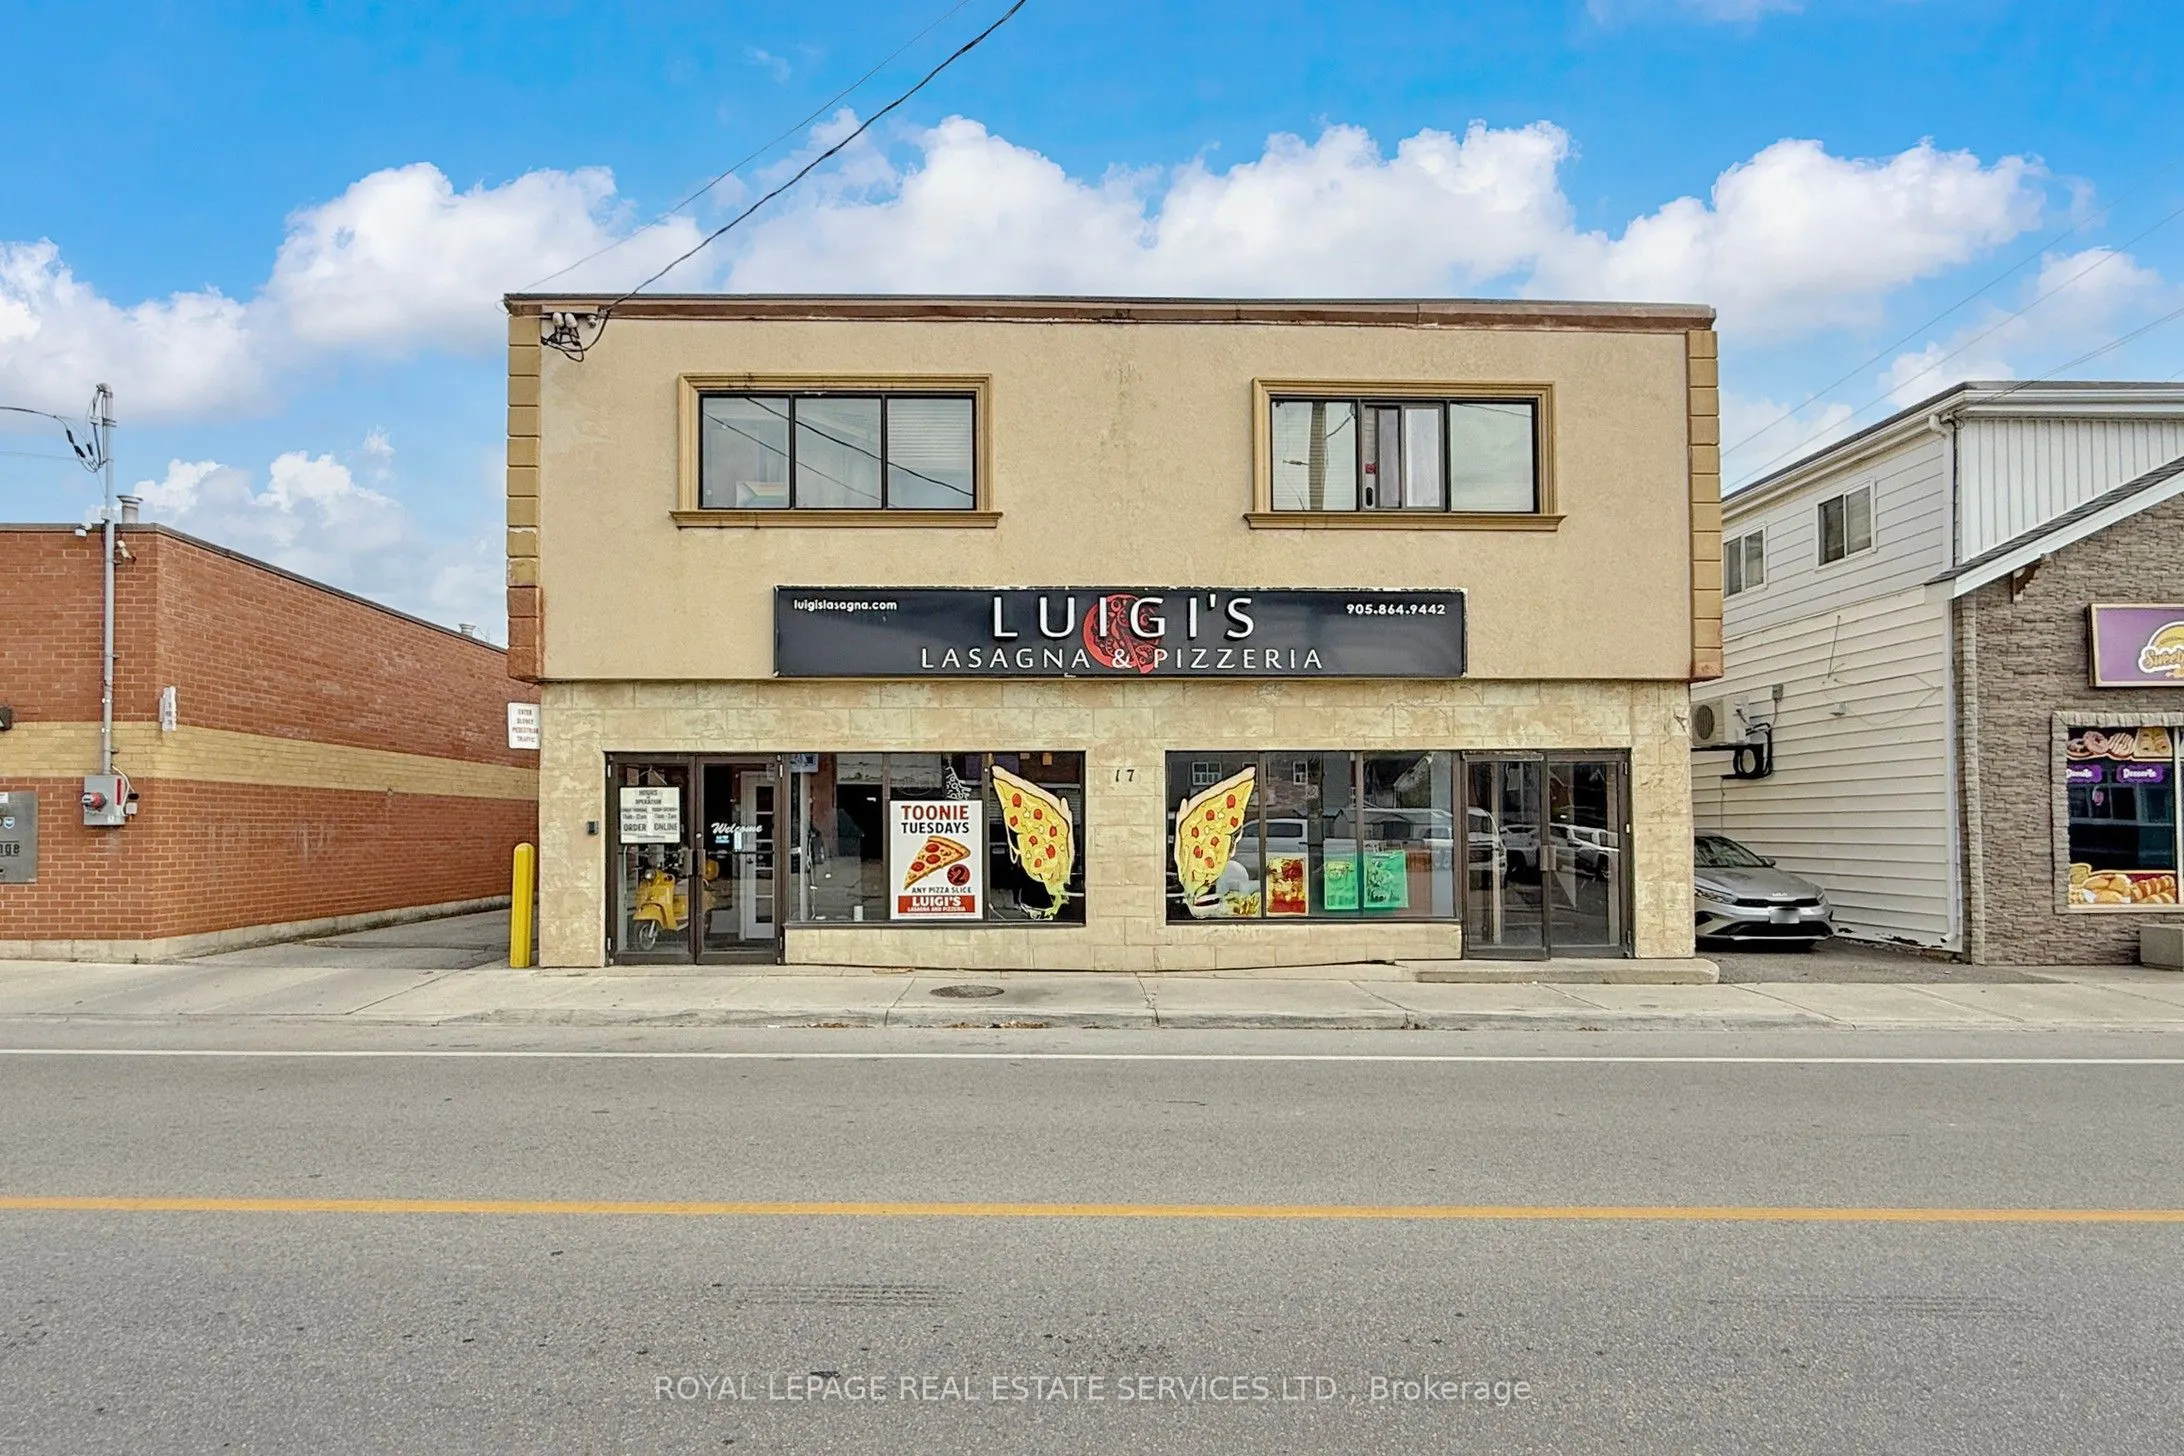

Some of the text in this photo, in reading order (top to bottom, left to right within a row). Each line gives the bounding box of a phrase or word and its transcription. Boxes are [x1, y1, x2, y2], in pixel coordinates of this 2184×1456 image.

[794, 599, 897, 612] luigislasagna.com
[1346, 603, 1446, 615] 905.864.9442
[993, 593, 1255, 638] LUIGI'S
[921, 648, 1323, 669] LASAGNA & PIZZERIA
[1115, 769, 1135, 782] 17
[901, 805, 969, 820] TOONIE
[623, 822, 678, 831] ORDER ONLINE
[711, 822, 763, 834] Welcome
[901, 822, 970, 834] TUESDAYS
[911, 896, 962, 907] LUIGI'S
